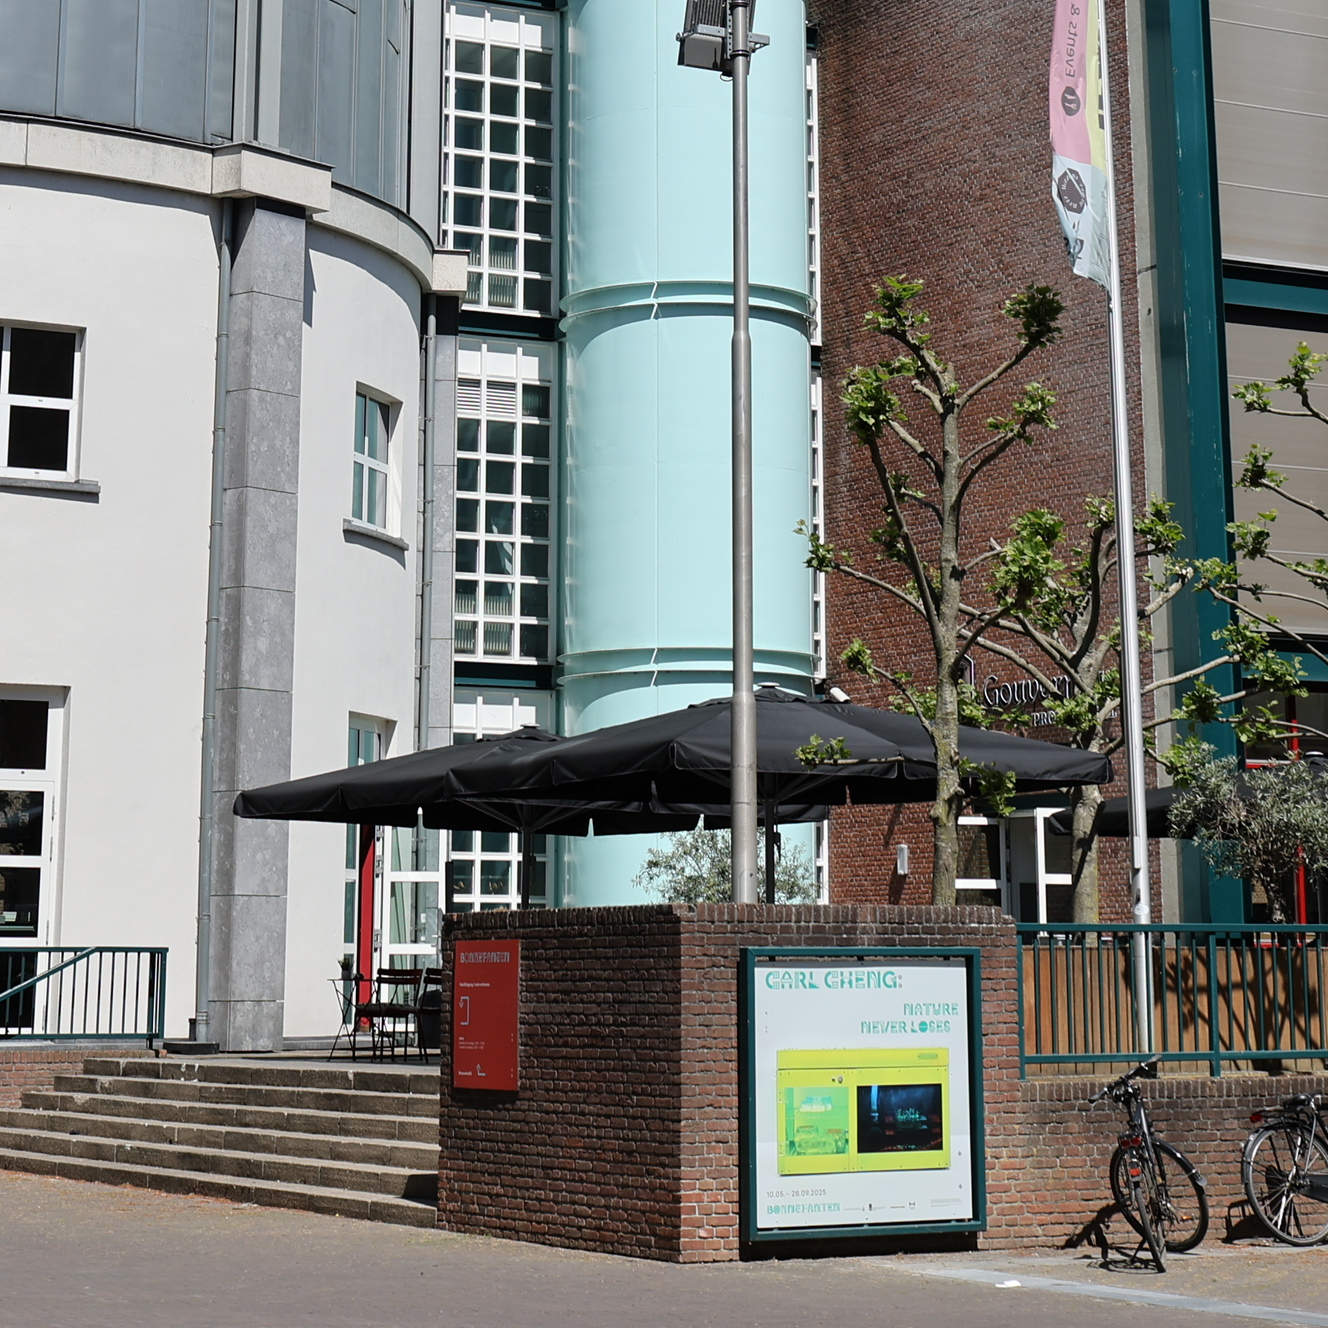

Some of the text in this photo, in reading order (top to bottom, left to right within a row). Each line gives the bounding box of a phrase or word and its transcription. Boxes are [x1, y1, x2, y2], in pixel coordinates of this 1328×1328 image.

[765, 971, 903, 990] CARL CHENG:
[903, 1002, 959, 1017] NATURE
[860, 1019, 951, 1034] NEVER LOSES
